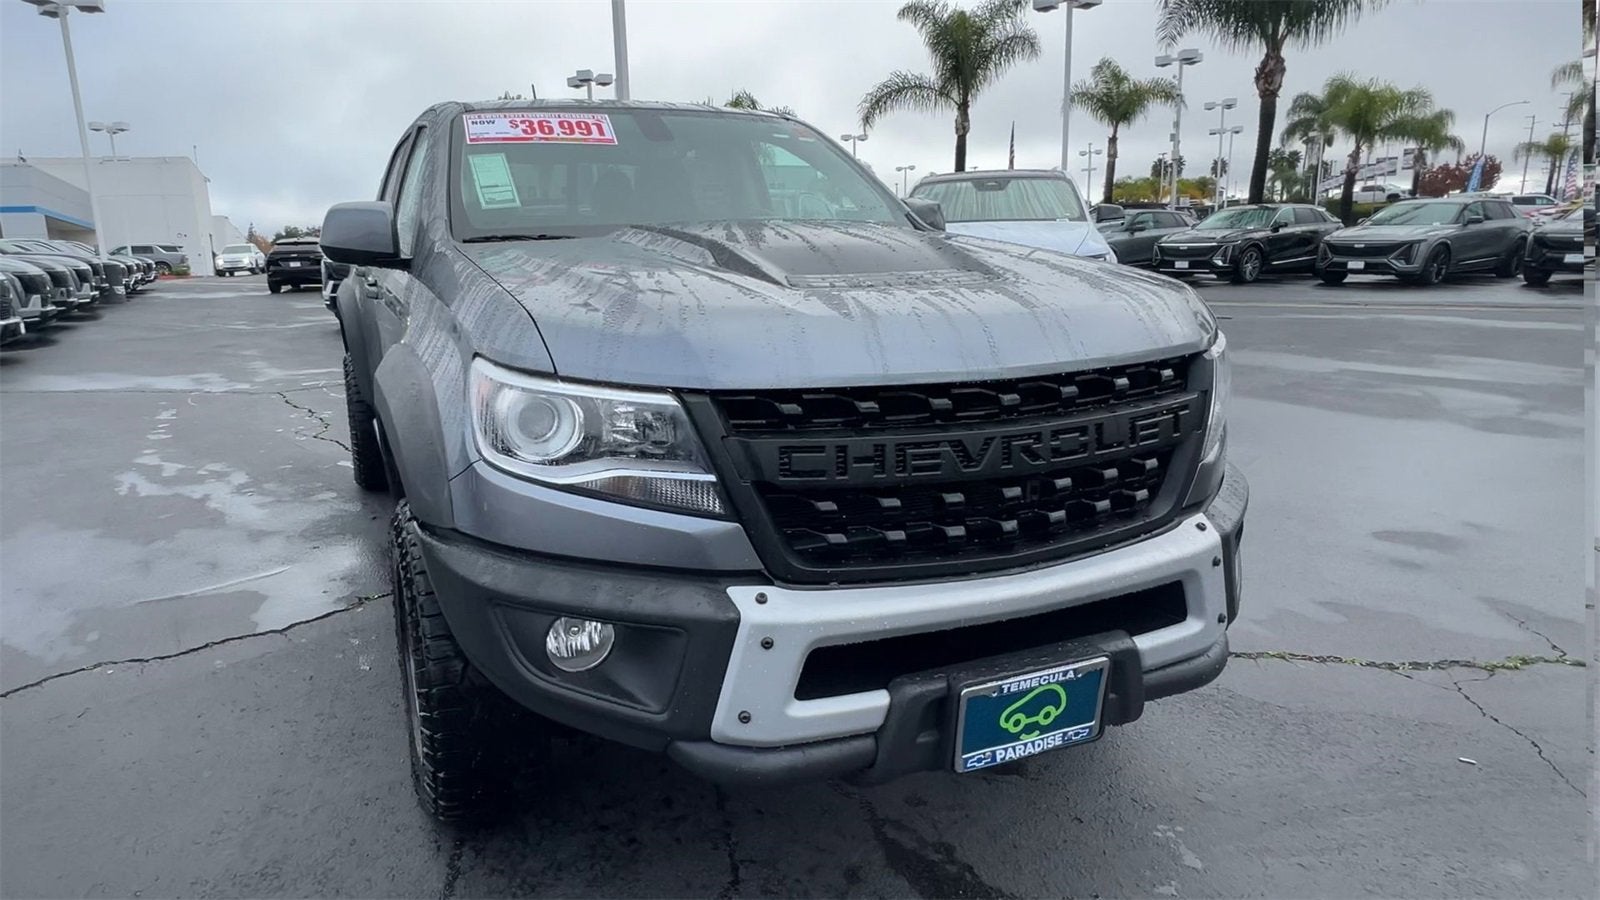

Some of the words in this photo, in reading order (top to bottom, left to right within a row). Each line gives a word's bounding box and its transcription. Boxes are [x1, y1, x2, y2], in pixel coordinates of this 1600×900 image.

[509, 119, 606, 137] $36,991
[777, 402, 1191, 481] CHEVROLET
[1001, 670, 1076, 694] TEMECULA
[995, 733, 1063, 762] PARADISE
